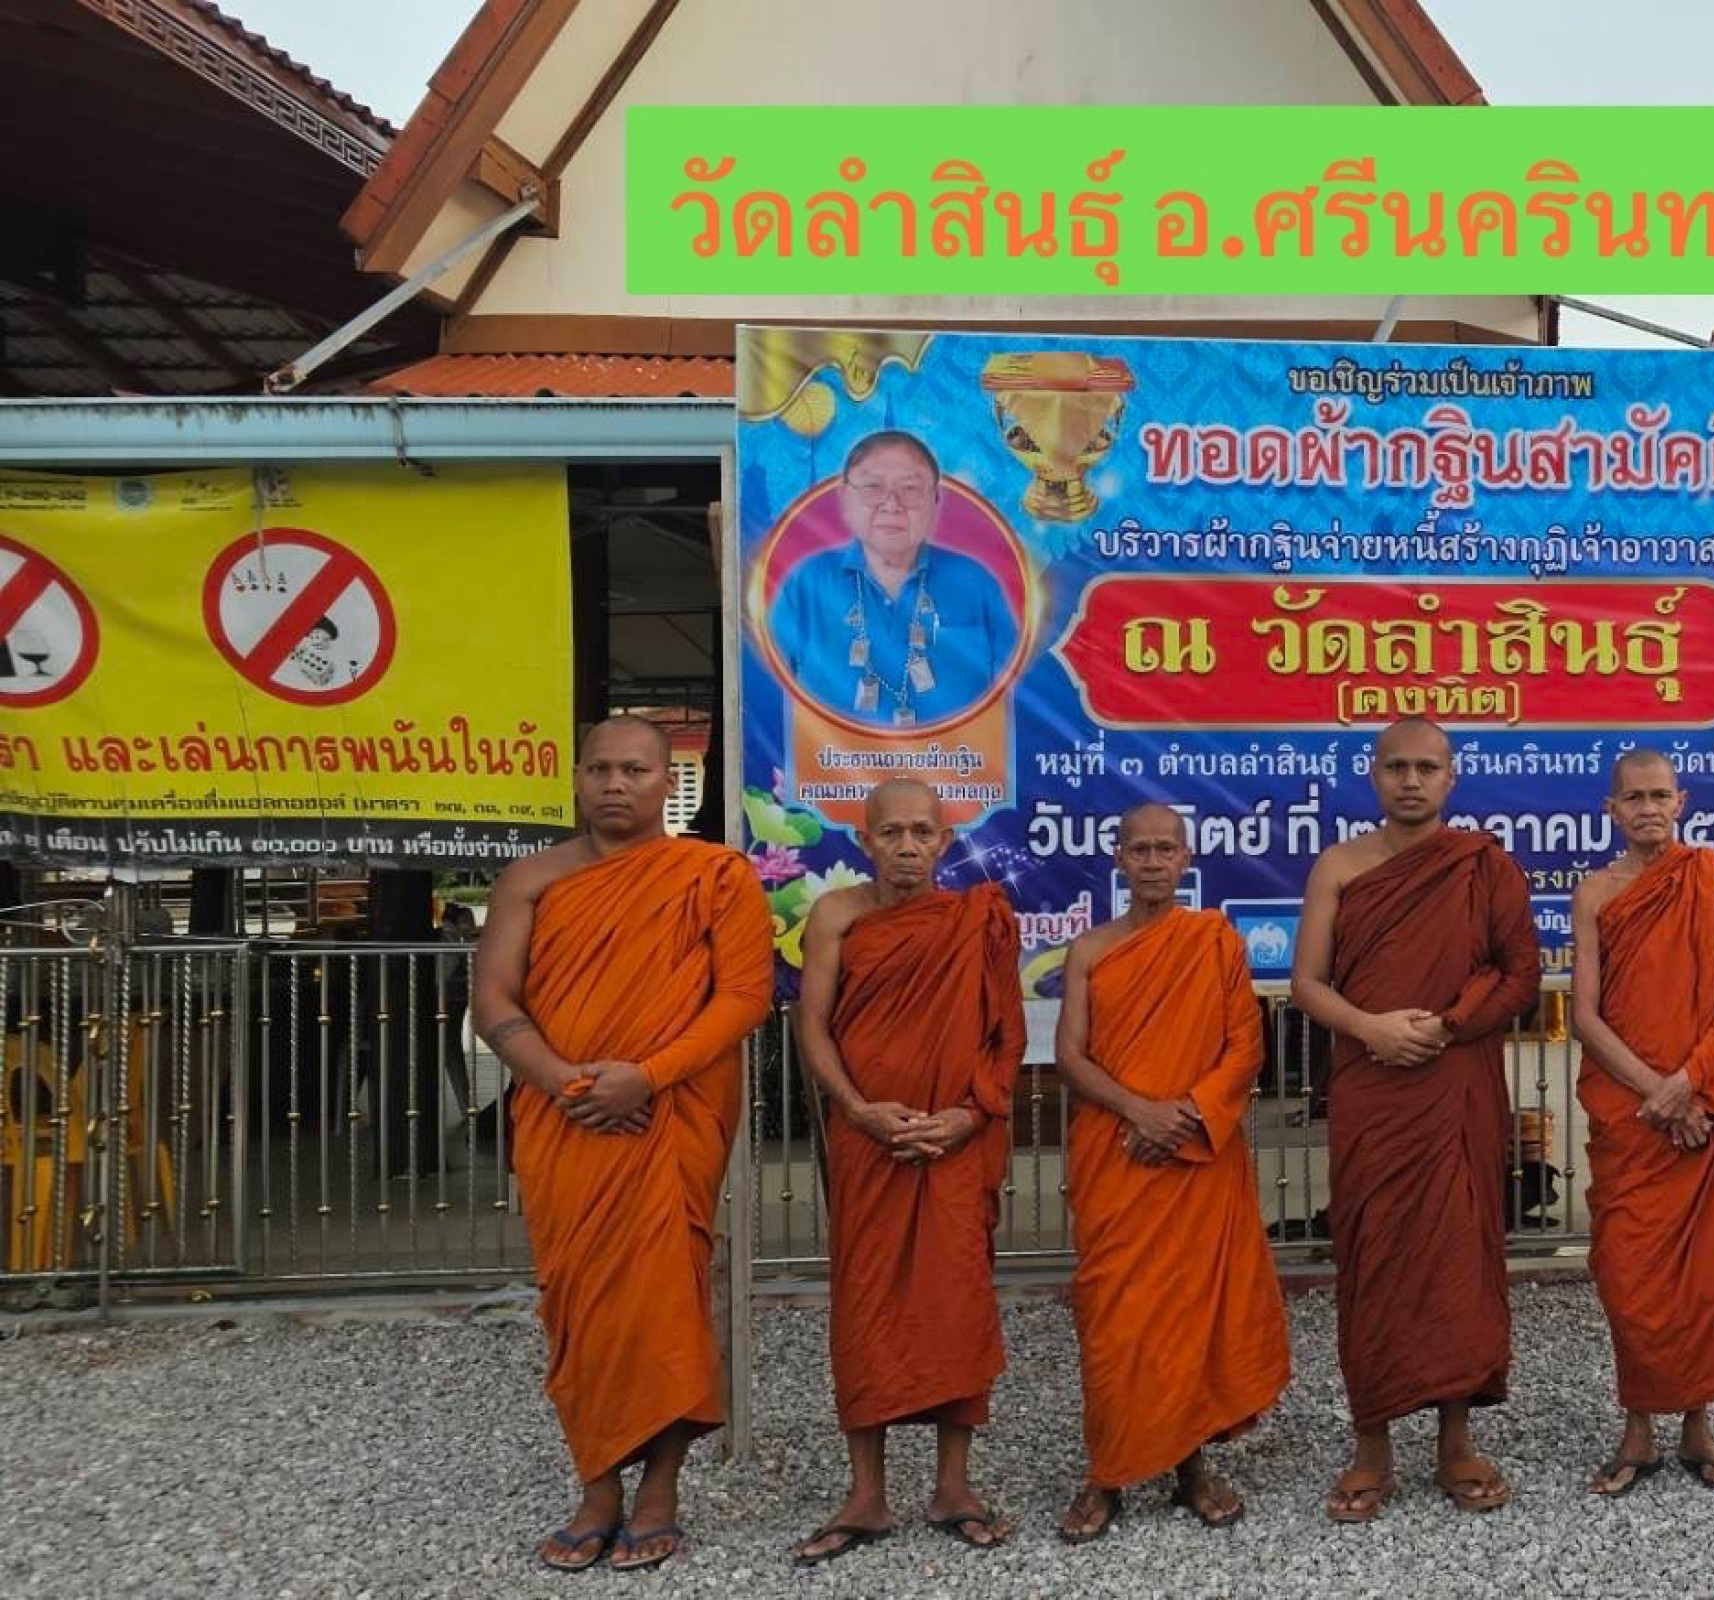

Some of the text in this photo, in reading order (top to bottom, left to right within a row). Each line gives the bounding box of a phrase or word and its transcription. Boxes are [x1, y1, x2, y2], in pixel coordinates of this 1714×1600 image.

[1288, 360, 1592, 403] ขอเชิญร่วมเป็นเจ้าภาพ
[1122, 585, 1687, 703] ณ วัดลำสินธุ์
[1036, 731, 1105, 788] หมู่ที่
[1121, 757, 1144, 776] ๓
[1288, 783, 1321, 856] ที่
